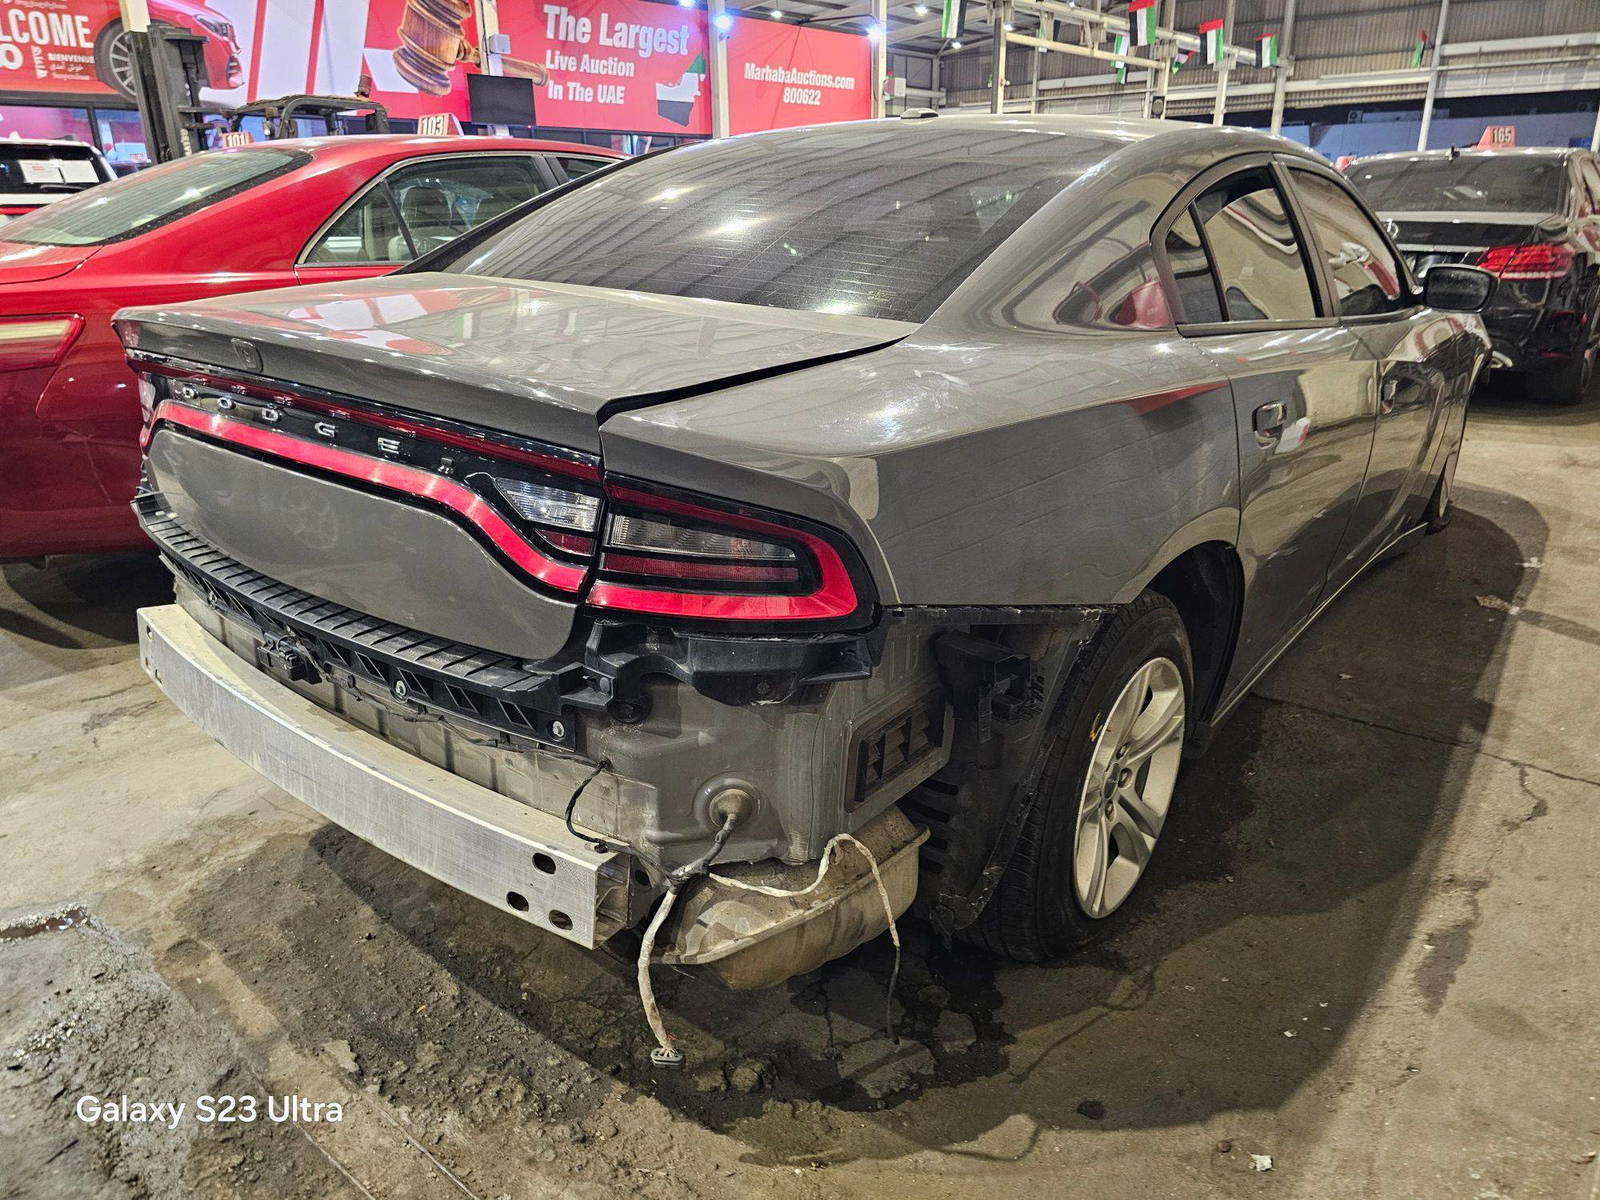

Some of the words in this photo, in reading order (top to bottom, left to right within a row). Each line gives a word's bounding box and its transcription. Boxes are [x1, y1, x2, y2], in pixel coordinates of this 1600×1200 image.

[543, 4, 592, 44] The
[599, 12, 690, 58] Largest
[545, 49, 577, 72] Live
[580, 53, 635, 77] Auction
[744, 62, 856, 90] MarhabaAuctions.com
[547, 80, 563, 100] In
[567, 81, 594, 103] The
[597, 84, 625, 104] UAE
[783, 86, 822, 106] 800622
[423, 116, 444, 135] 103
[1492, 127, 1512, 144] 165
[226, 134, 246, 148] 101
[182, 385, 401, 455] DODGE
